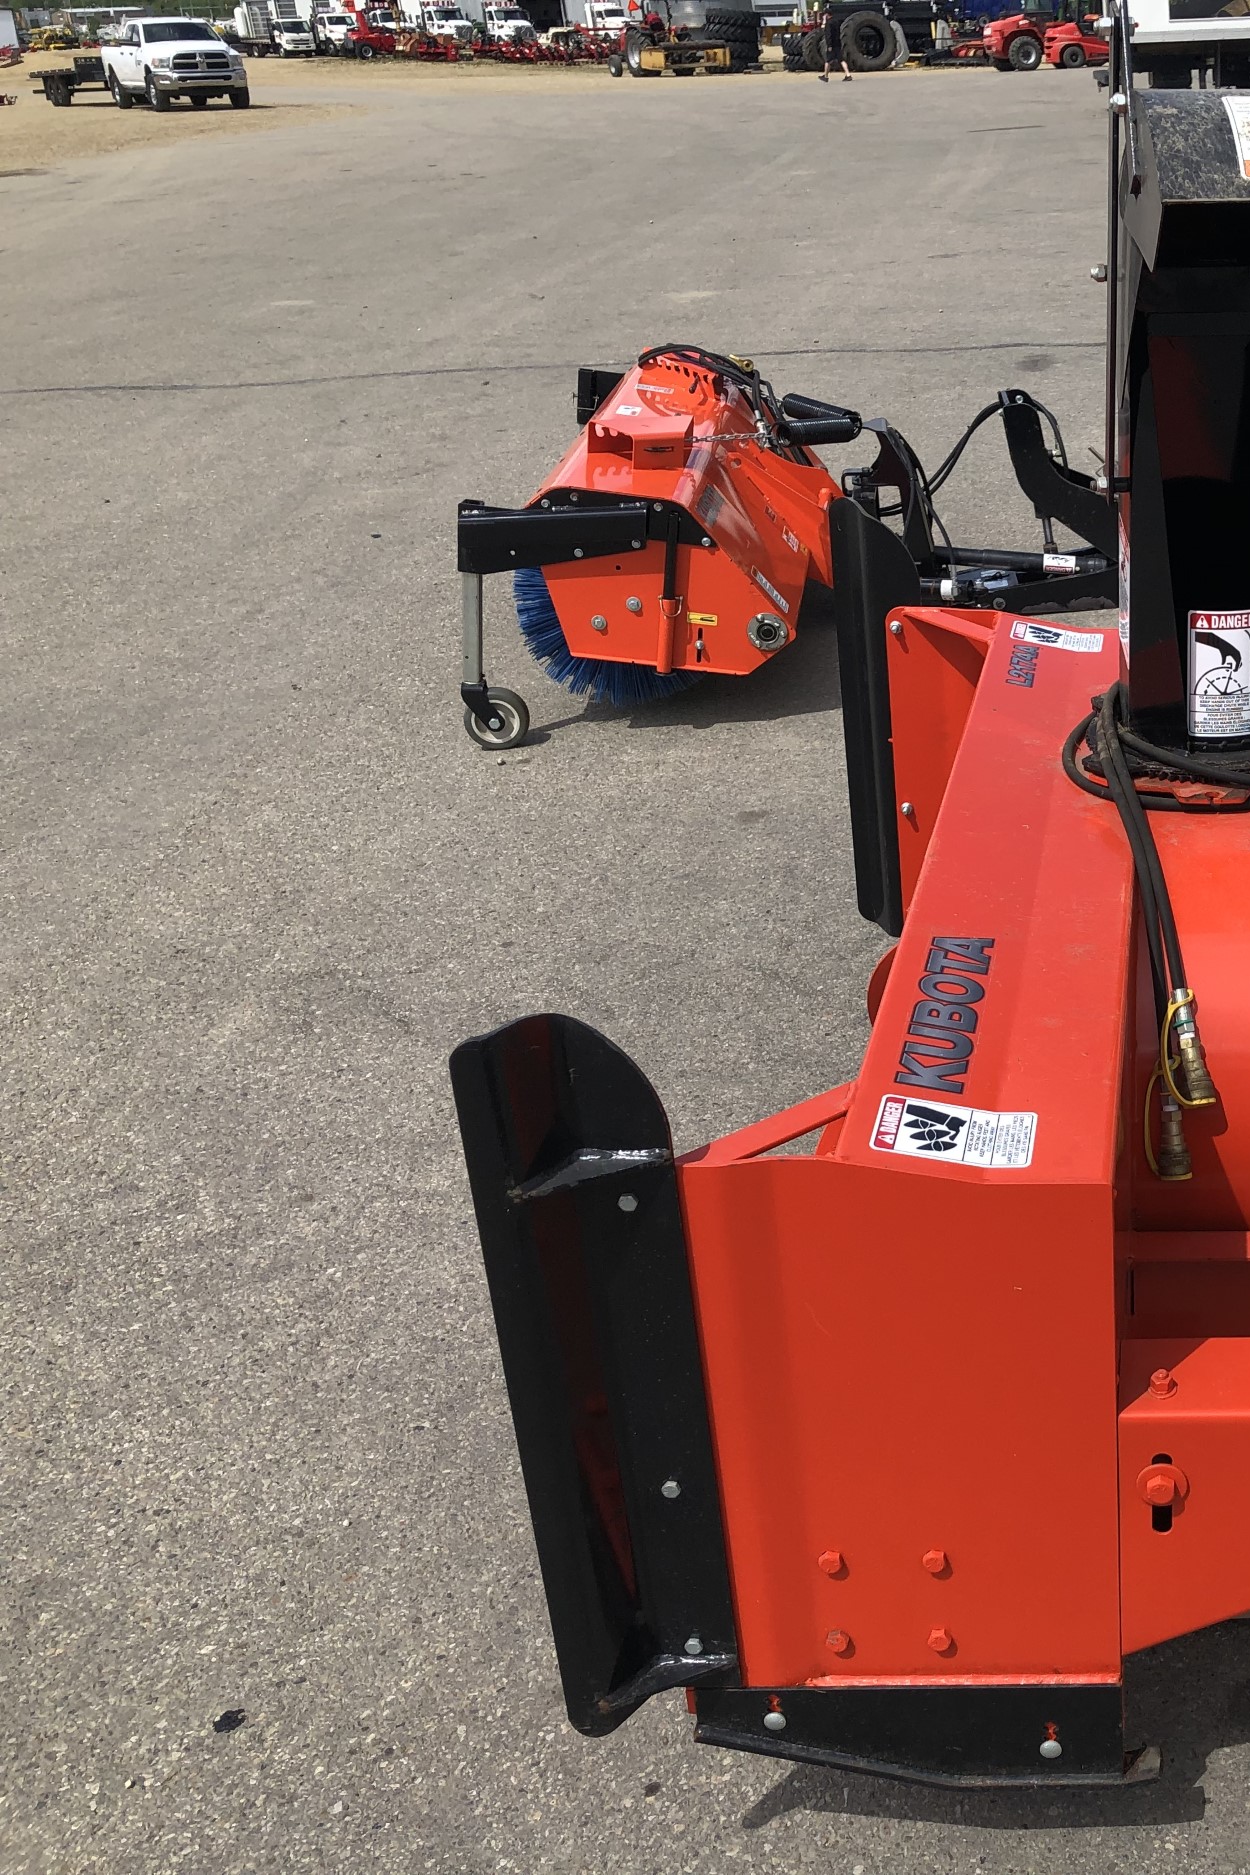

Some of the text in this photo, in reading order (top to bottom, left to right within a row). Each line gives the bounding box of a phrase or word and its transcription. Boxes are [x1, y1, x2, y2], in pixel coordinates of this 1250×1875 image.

[1006, 645, 1040, 688] L2174A
[894, 936, 996, 1094] KUBOTA
[885, 1102, 904, 1134] DANGER
